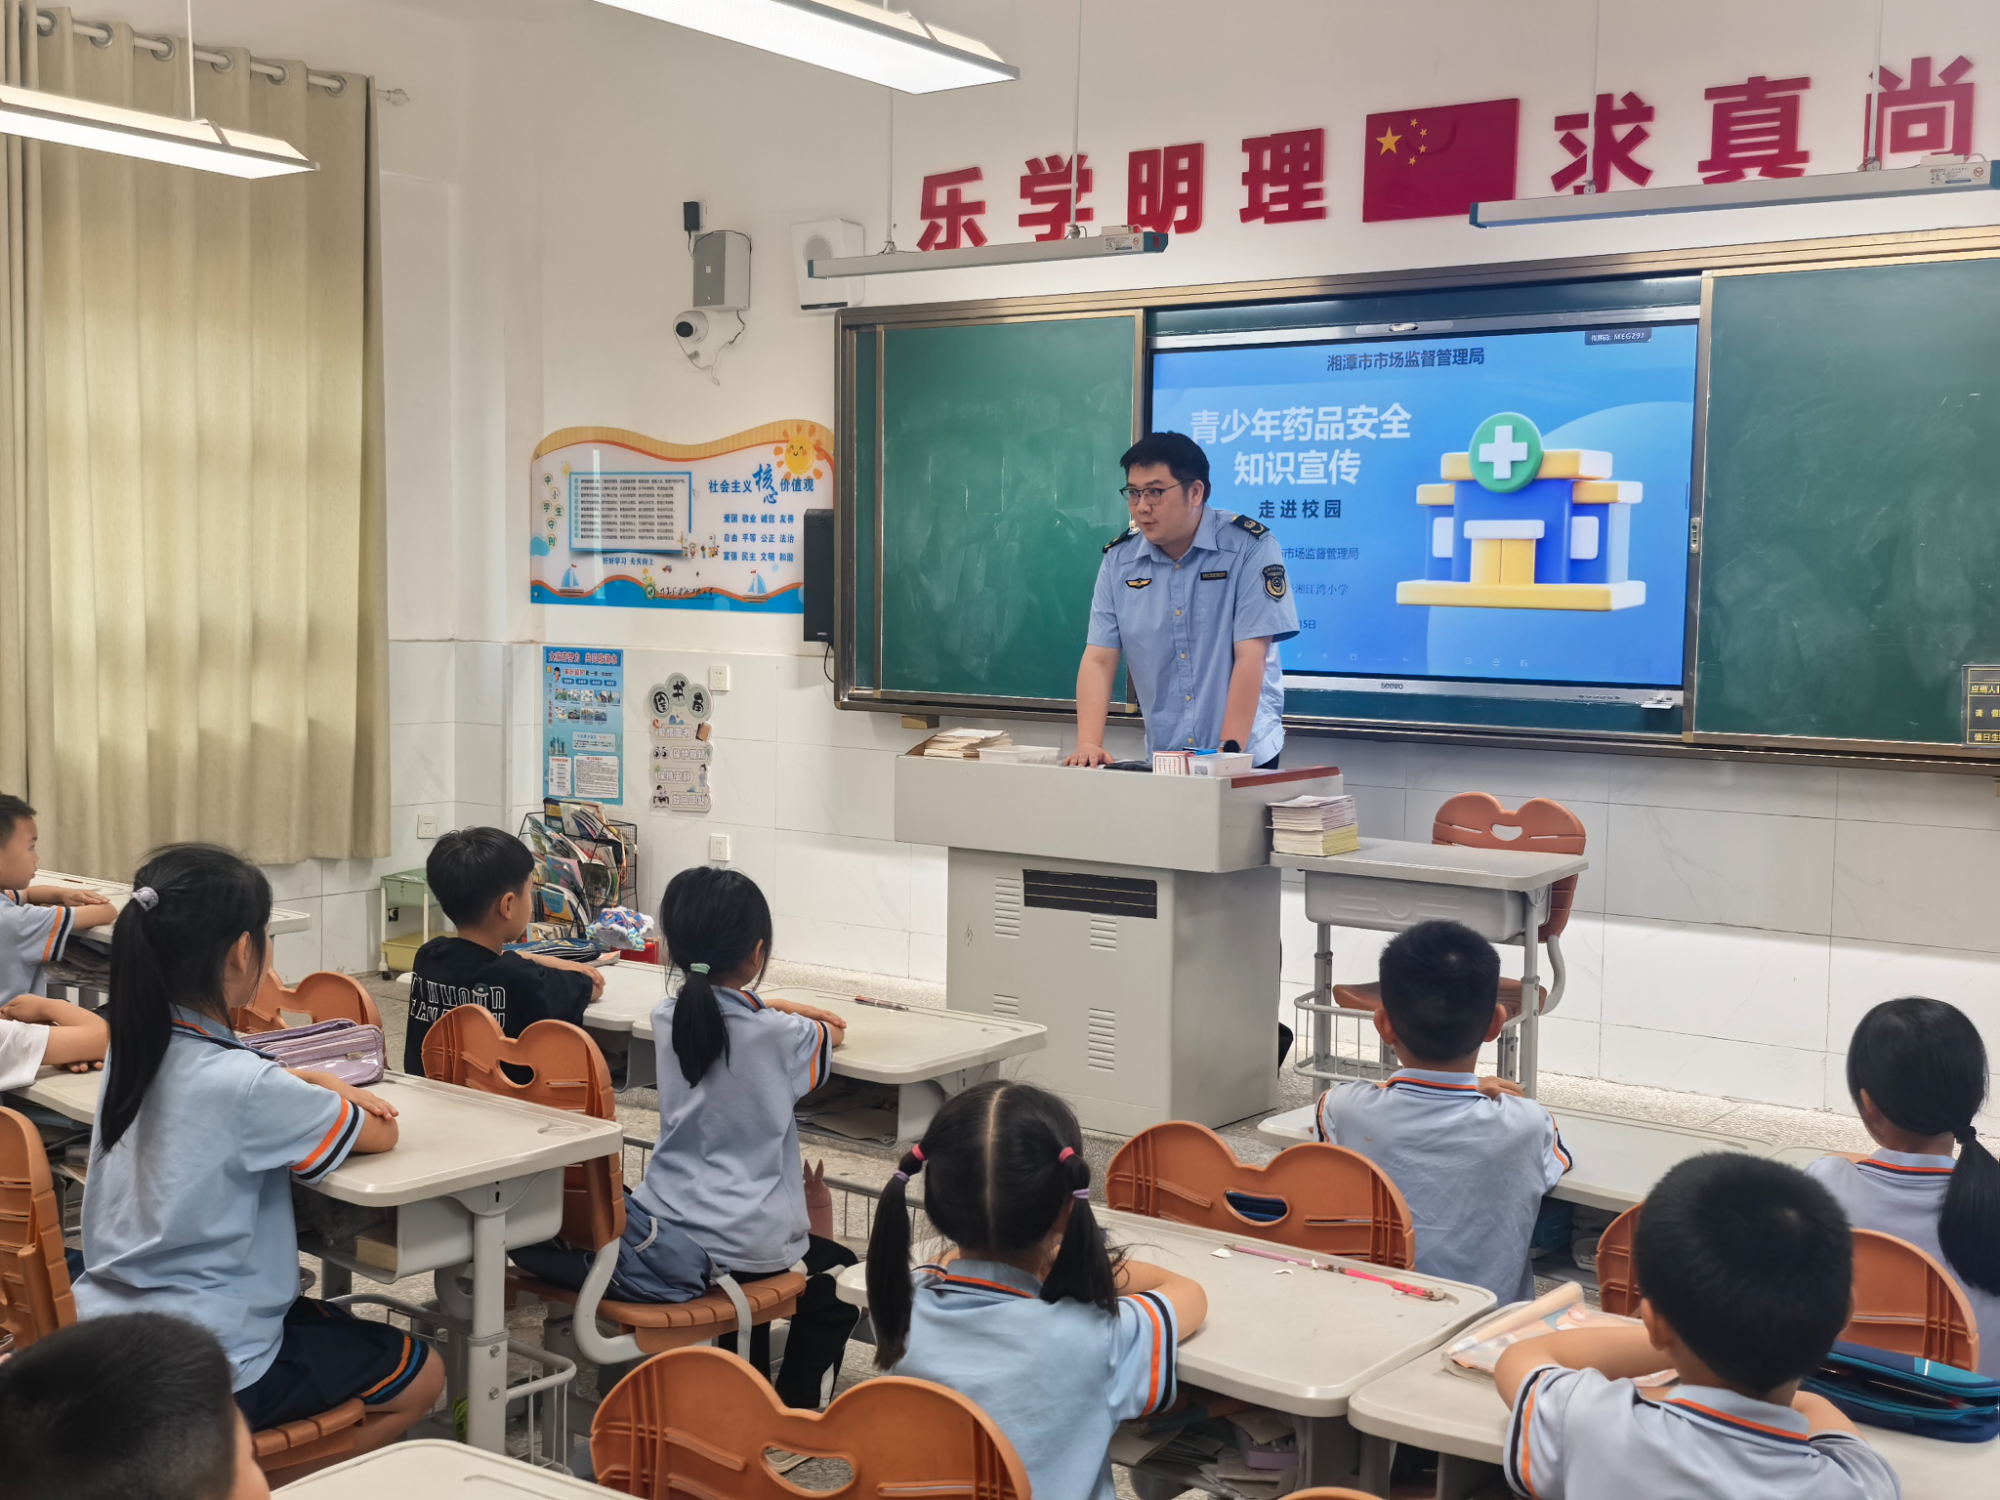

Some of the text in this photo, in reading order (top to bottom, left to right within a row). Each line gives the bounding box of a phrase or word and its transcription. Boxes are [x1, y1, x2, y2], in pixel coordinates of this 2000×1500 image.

[917, 55, 1975, 252] 乐学明理 求真尚
[1327, 347, 1485, 372] 湘潭市市场监督管理局
[1190, 402, 1412, 445] 青少年药品安全
[1234, 448, 1361, 486] 知识宣传
[1258, 499, 1342, 519] 走进校园
[1292, 583, 1349, 596] 湘江湾小学
